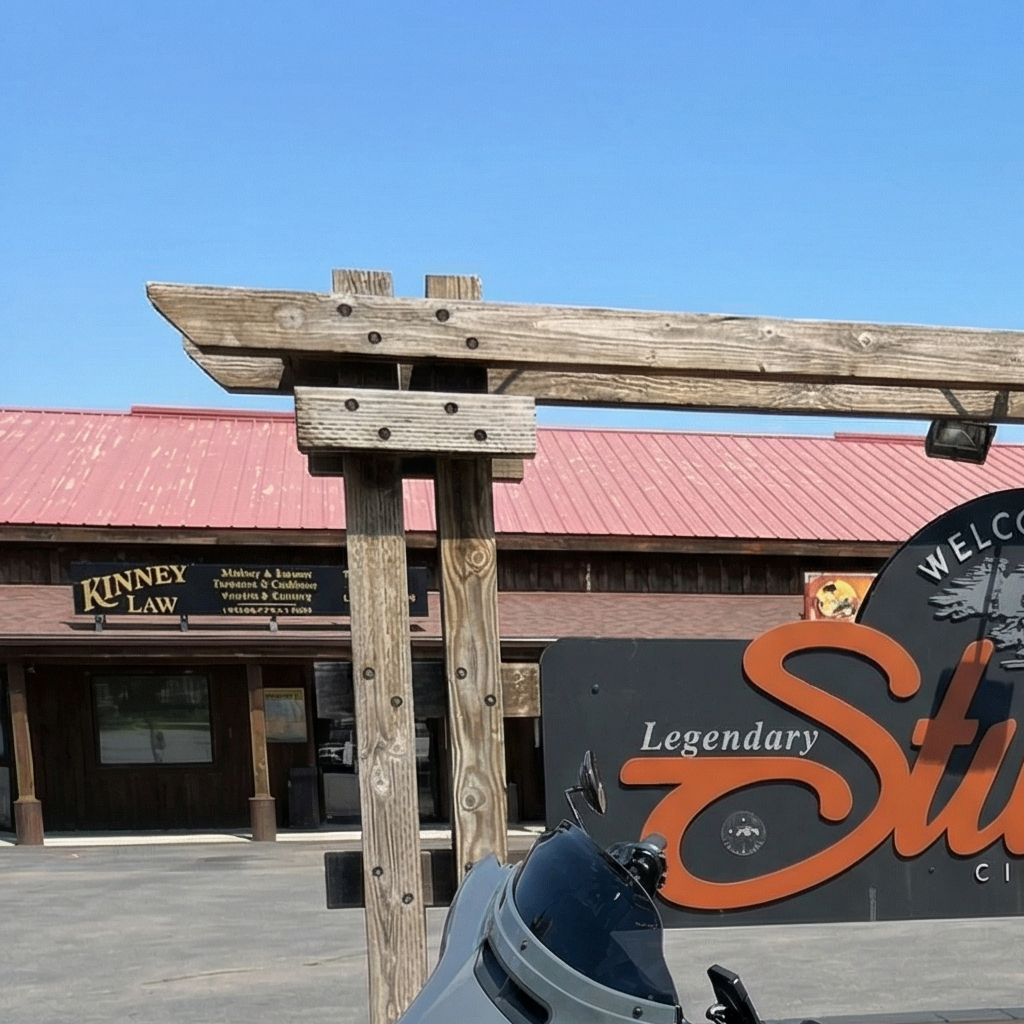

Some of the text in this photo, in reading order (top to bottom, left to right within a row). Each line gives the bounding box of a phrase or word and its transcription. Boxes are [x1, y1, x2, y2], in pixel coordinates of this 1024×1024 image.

[81, 564, 187, 612] KINNEY
[126, 595, 178, 613] LAW
[640, 721, 819, 758] Legendary
